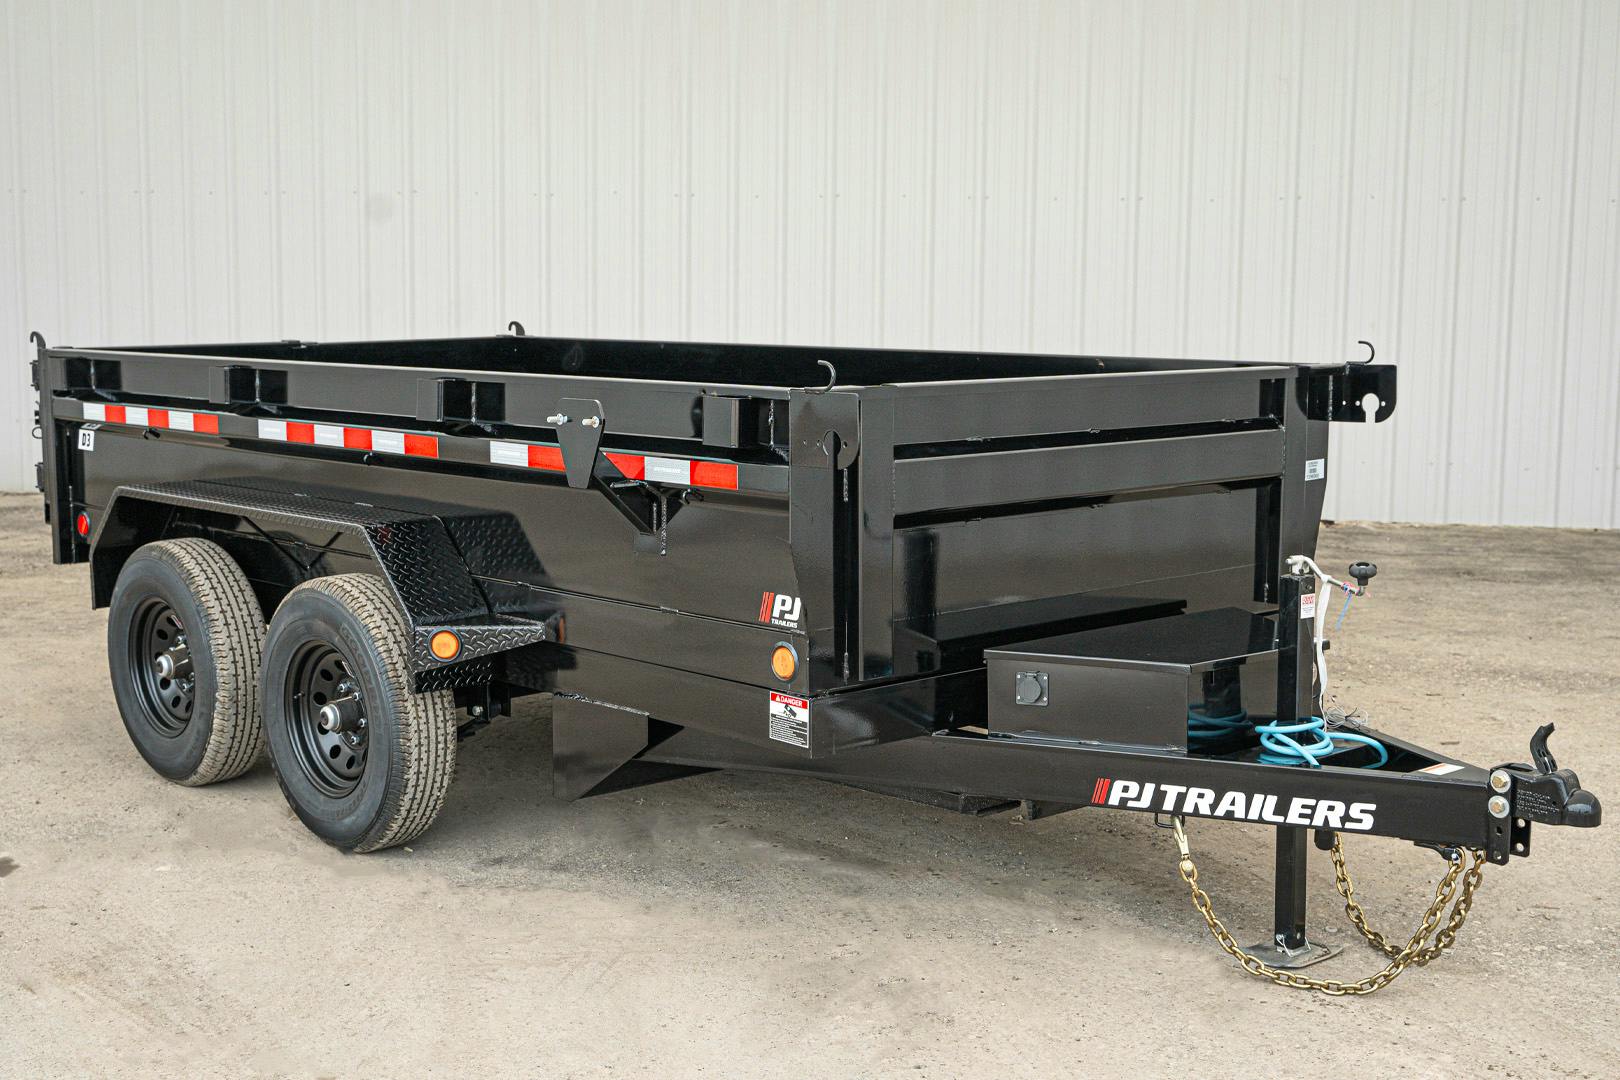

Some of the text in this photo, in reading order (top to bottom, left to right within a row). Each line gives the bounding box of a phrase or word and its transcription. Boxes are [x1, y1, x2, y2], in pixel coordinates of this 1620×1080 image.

[772, 594, 802, 621] PJ
[771, 618, 798, 628] TRAILERS
[780, 696, 803, 707] DANGER
[1108, 780, 1377, 830] PJ TRAILERS
